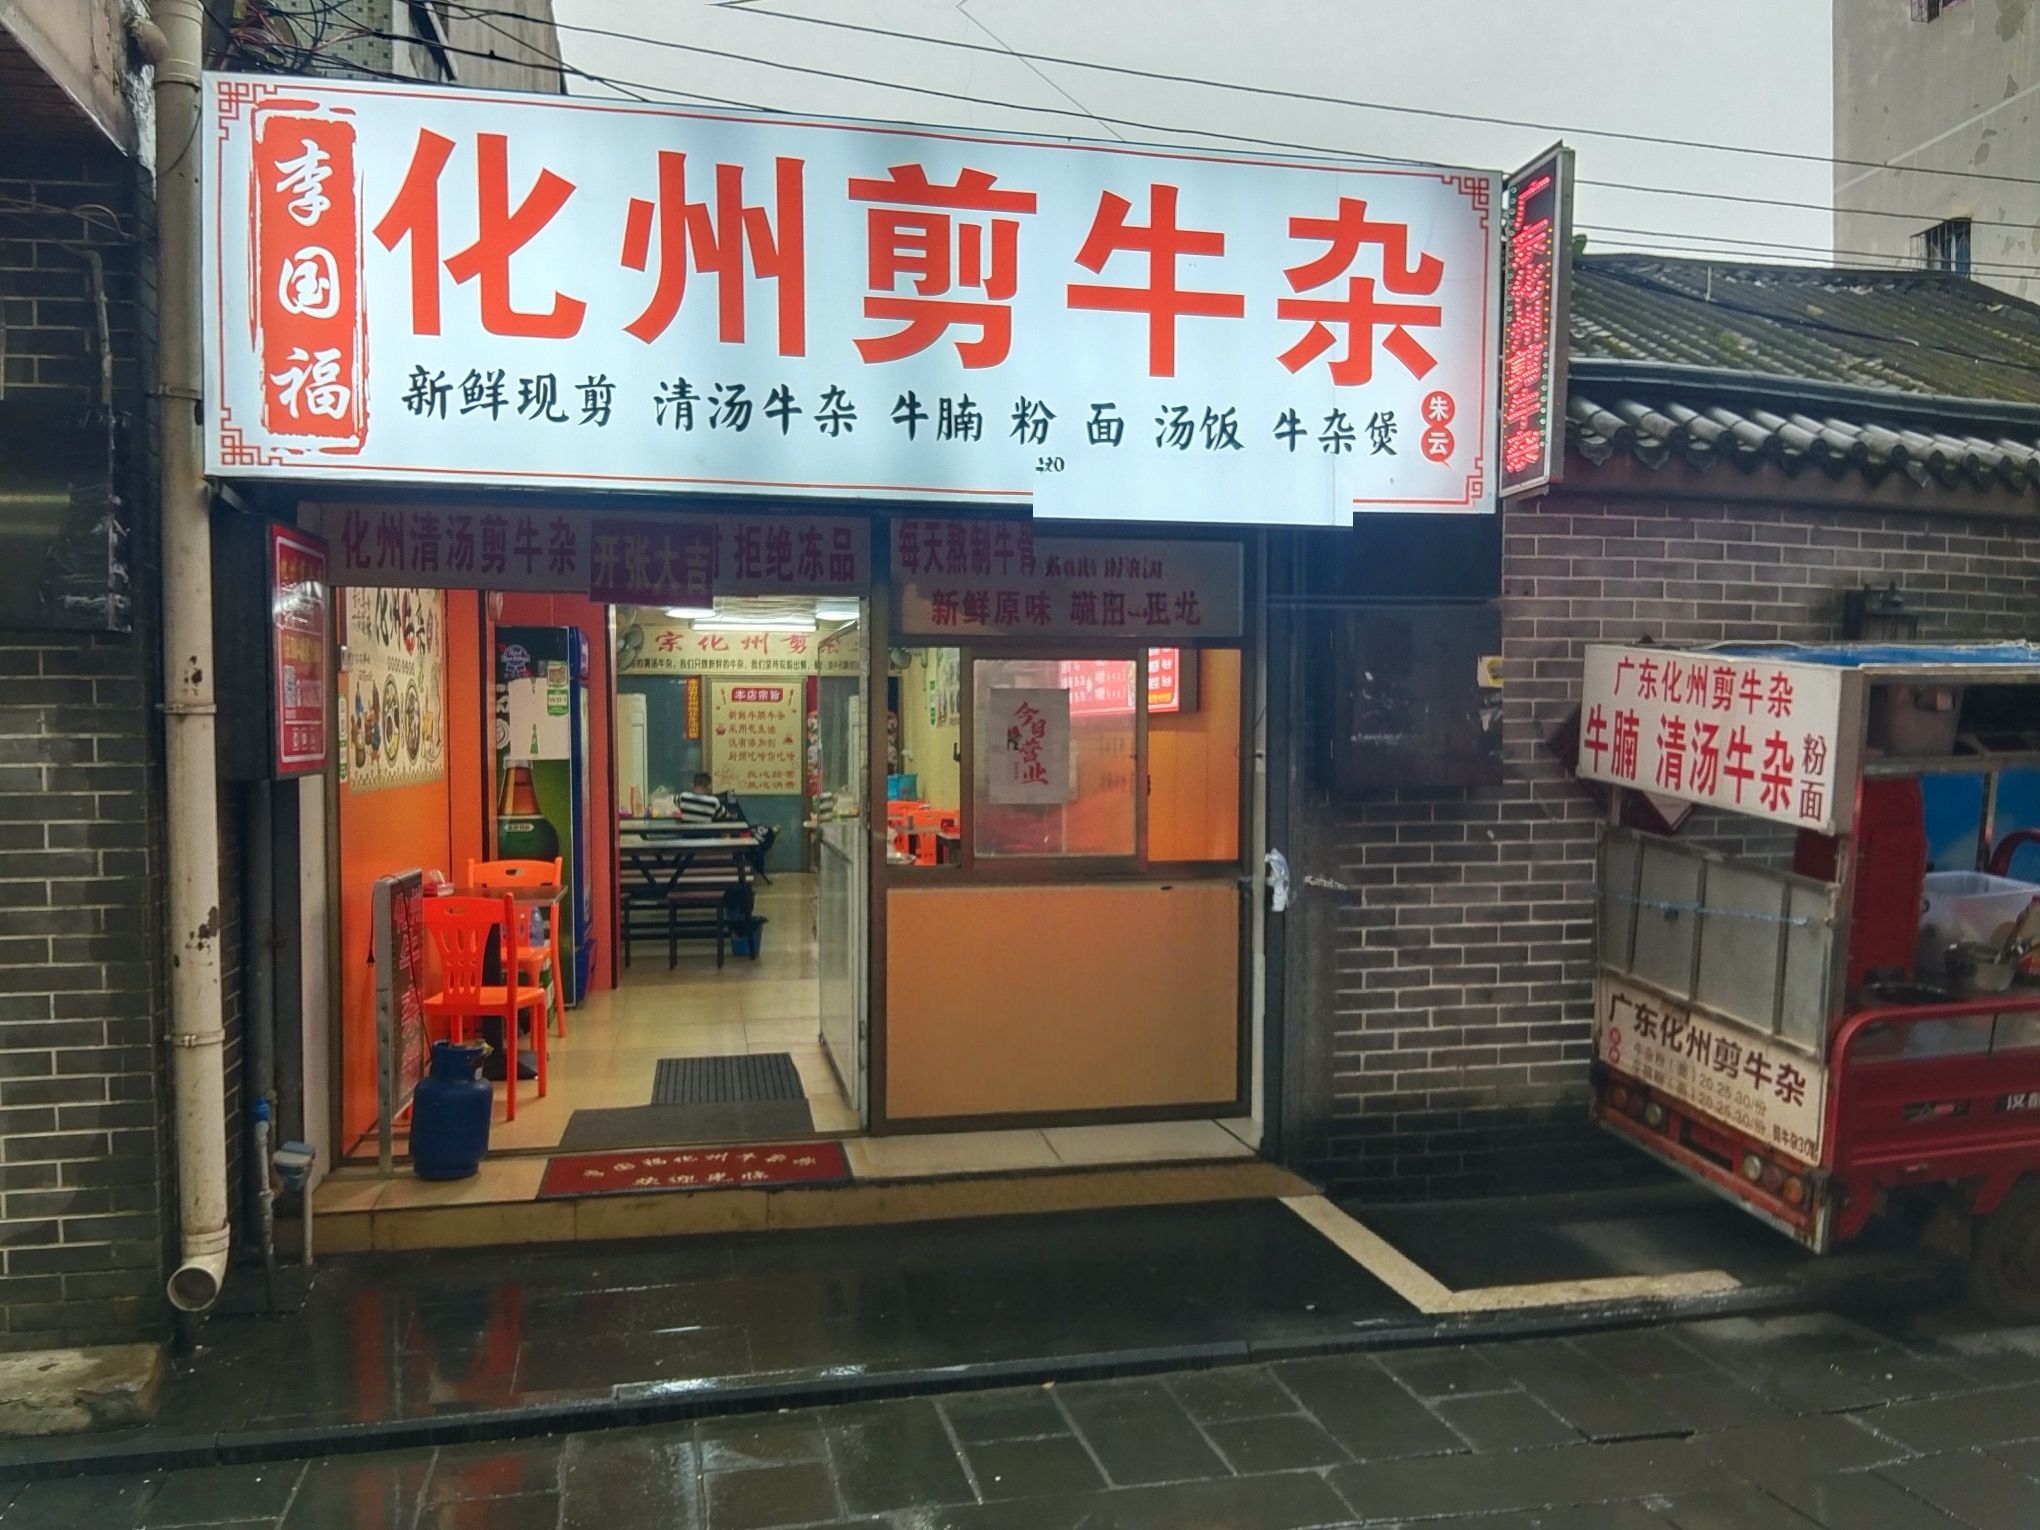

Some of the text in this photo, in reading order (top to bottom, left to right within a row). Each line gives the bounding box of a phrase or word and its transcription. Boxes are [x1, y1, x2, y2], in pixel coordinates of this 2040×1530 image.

[269, 138, 350, 420] 李国福
[373, 127, 1444, 387] 化州剪牛杂
[401, 364, 1398, 457] 新鲜现剪 清汤牛杂 牛腩 粉 面 汤饭 牛杂煲
[1428, 395, 1450, 455] 朱云
[340, 511, 577, 576] 化州清汤剪牛杂
[594, 534, 708, 595] 开张大吉
[733, 521, 856, 583] 拒绝冻品
[931, 589, 1051, 626] 新鲜原味
[735, 689, 780, 701] 本店宗旨
[1613, 655, 1794, 719] 广东化州剪牛杂
[1014, 701, 1049, 785] 今日营业
[1583, 703, 1828, 823] 牛腩 清汤牛杂 粉面
[1609, 993, 1807, 1107] 广东化州剪牛杂
